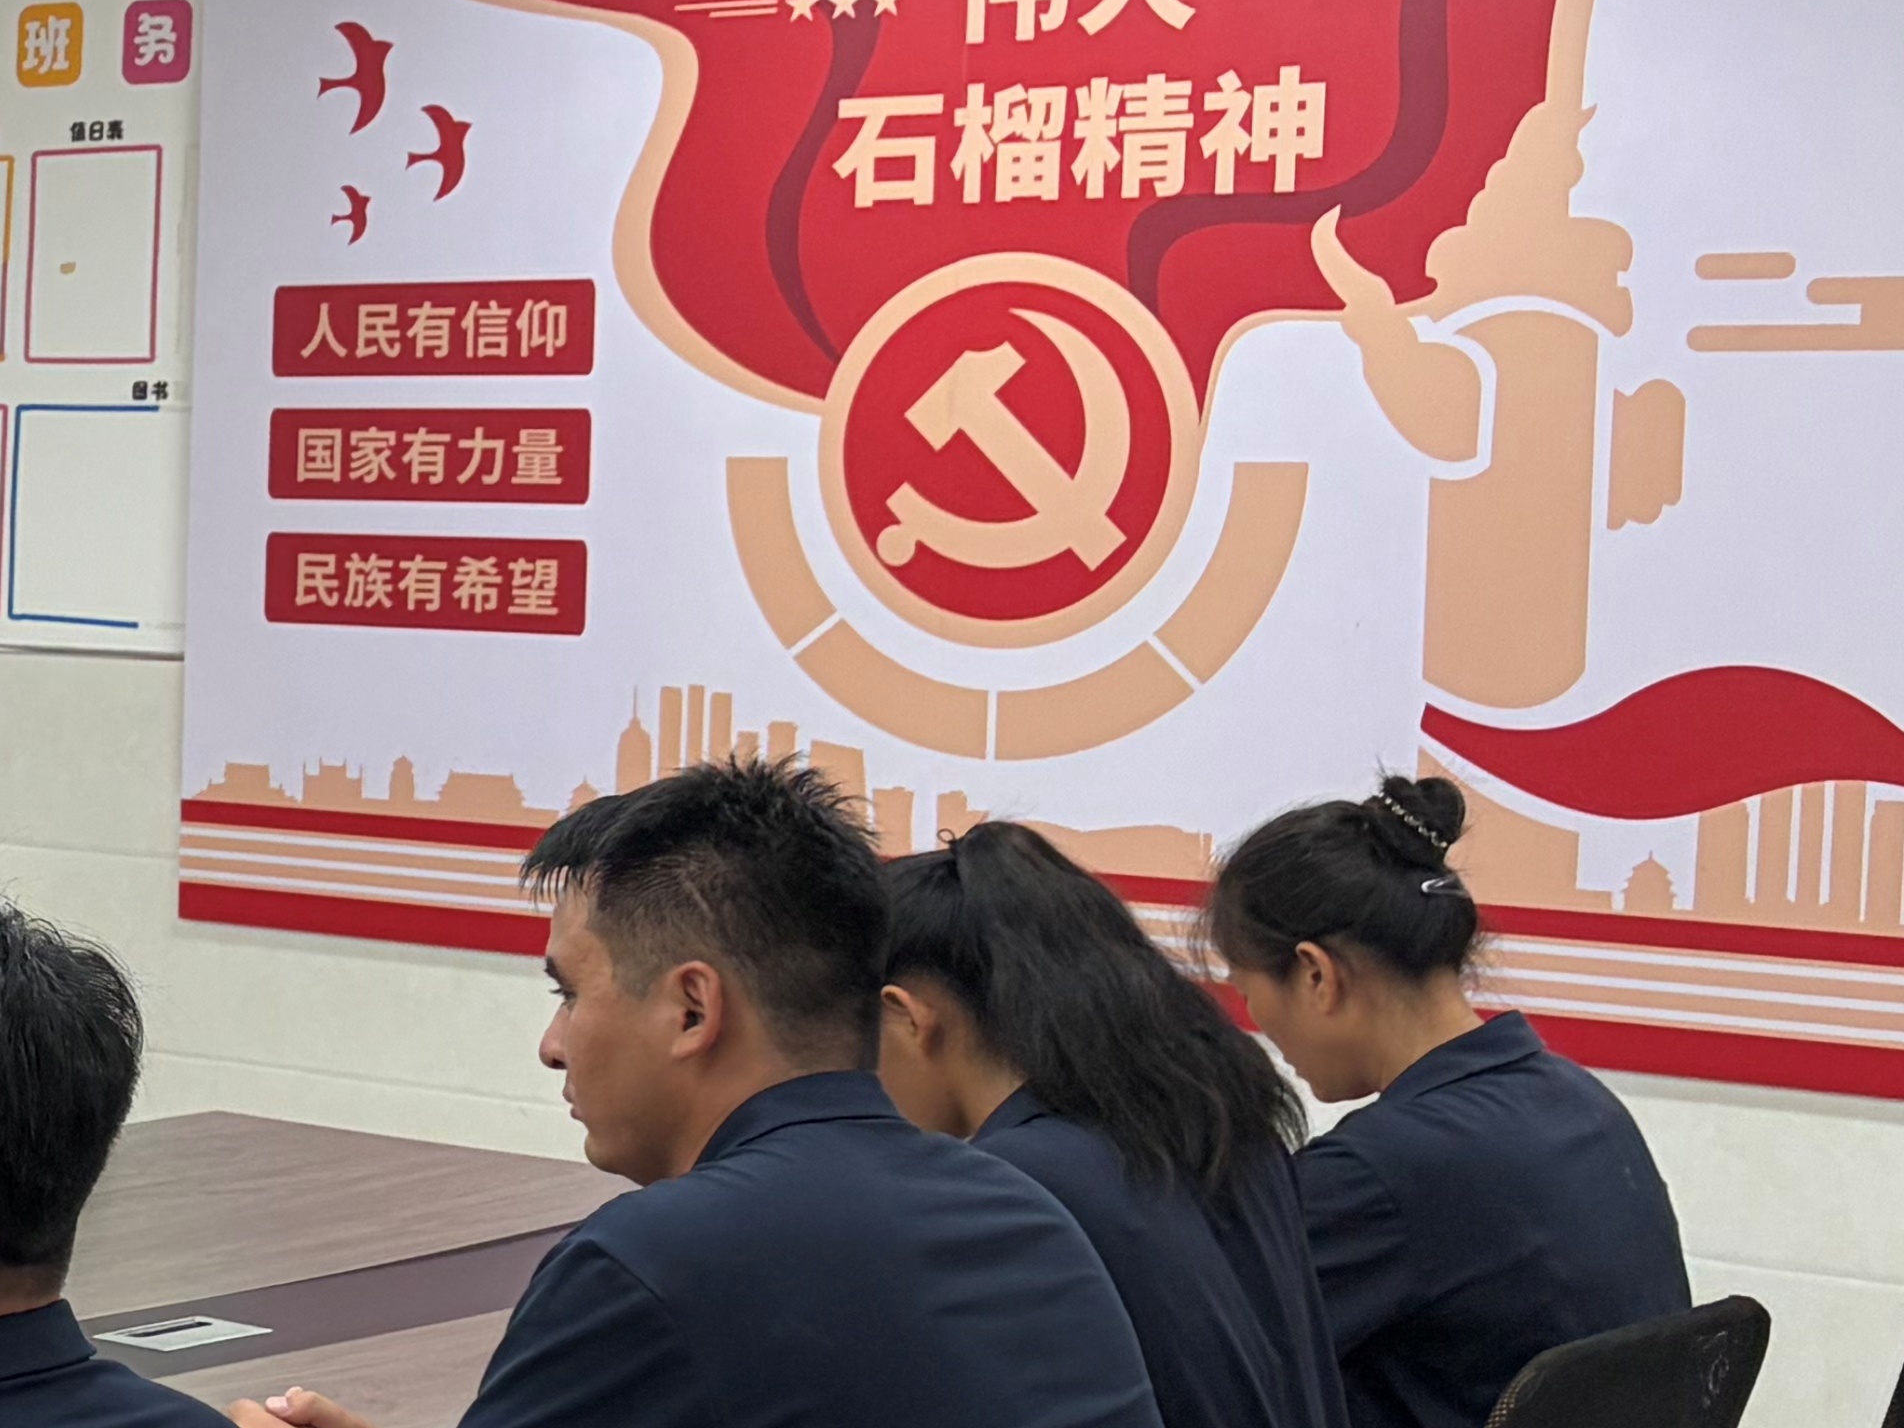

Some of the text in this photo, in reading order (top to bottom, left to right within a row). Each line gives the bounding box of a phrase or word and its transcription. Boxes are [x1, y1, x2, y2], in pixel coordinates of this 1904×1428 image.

[69, 119, 125, 142] 值日表
[831, 64, 1327, 208] 石榴精神
[300, 299, 568, 359] 人民有信仰
[296, 426, 564, 485] 国家有力量
[294, 552, 560, 616] 民族有希望
